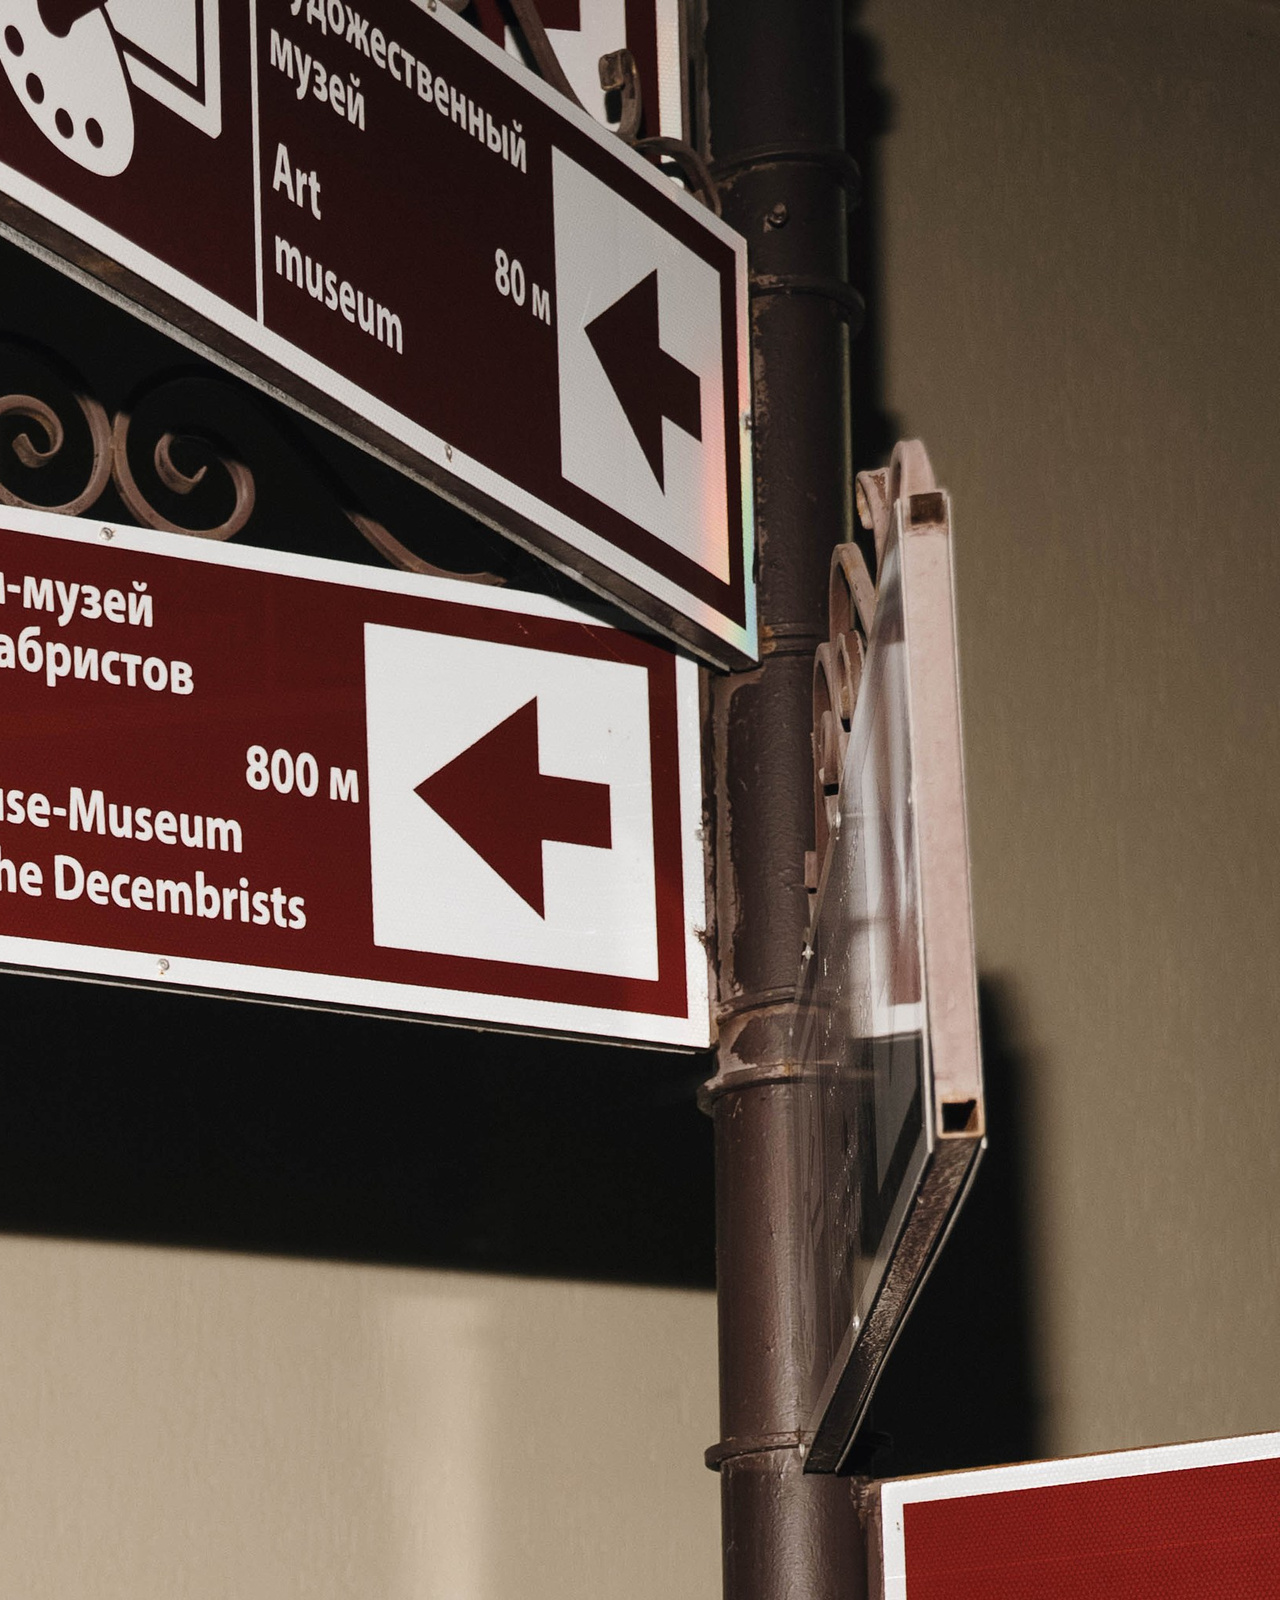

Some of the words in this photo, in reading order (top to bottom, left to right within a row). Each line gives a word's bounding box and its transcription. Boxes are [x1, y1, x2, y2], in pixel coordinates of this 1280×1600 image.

[270, 28, 365, 131] музей
[272, 142, 321, 221] Art
[275, 235, 403, 355] museum
[495, 248, 526, 307] 80
[532, 283, 551, 326] м
[245, 744, 319, 798] 800
[329, 766, 360, 804] м
[54, 854, 307, 930] Decembrists
